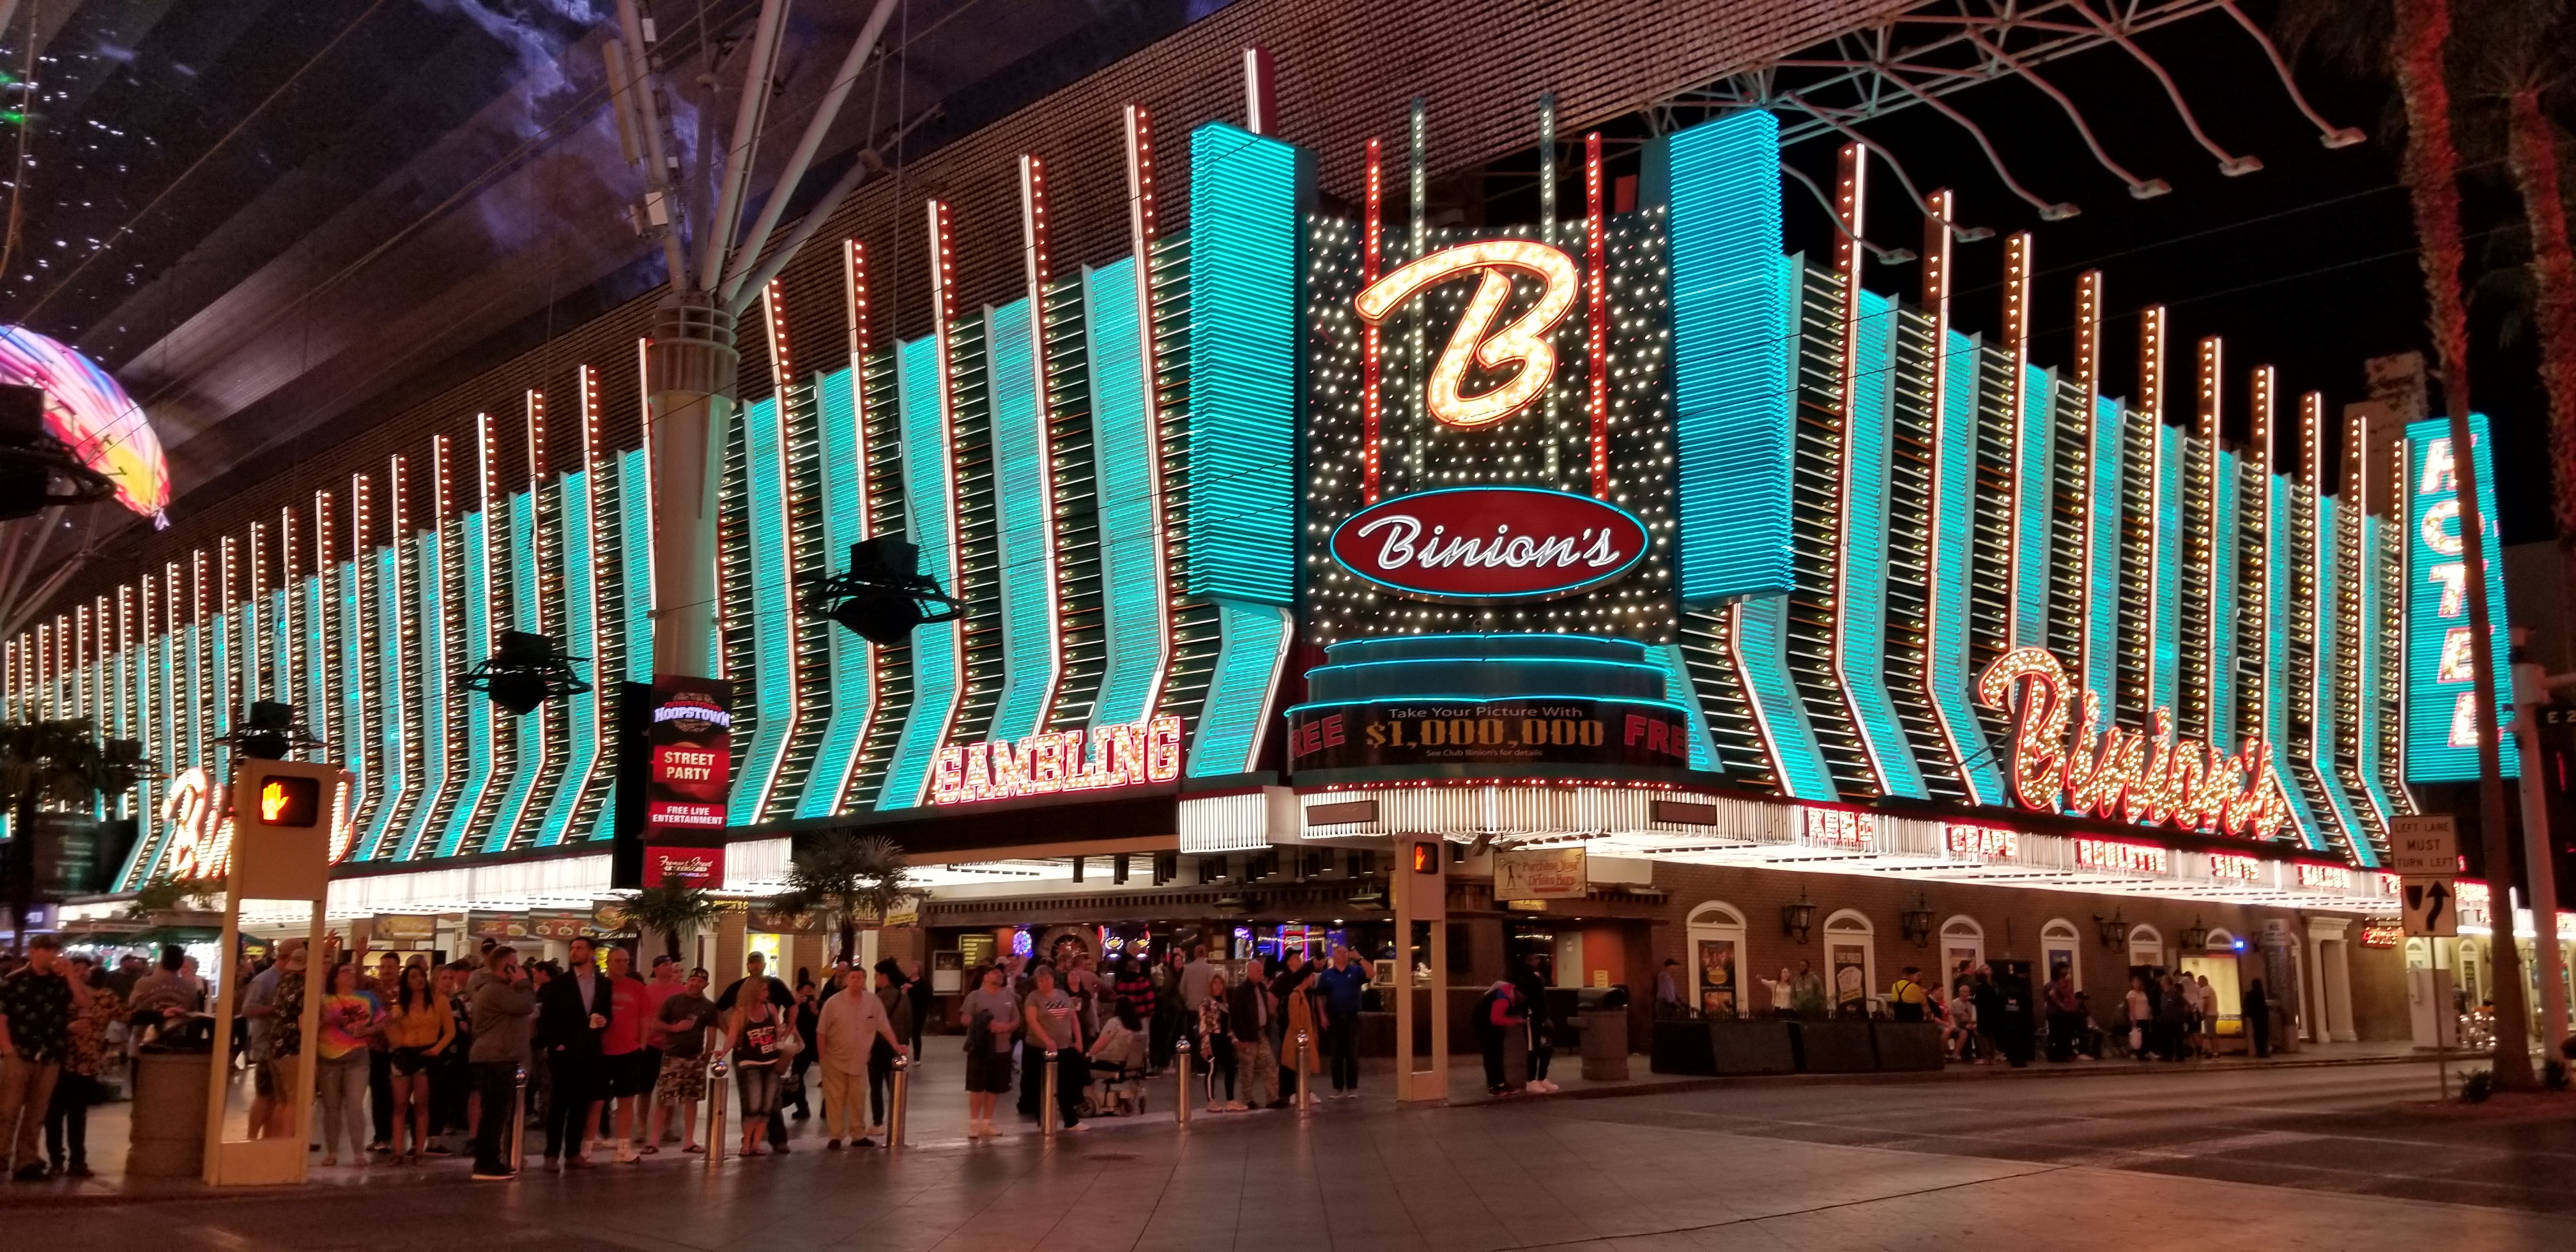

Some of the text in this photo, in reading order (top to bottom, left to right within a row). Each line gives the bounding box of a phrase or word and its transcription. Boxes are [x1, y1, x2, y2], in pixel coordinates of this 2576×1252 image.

[1354, 240, 1579, 427] B
[1358, 514, 1621, 570] Binion's
[654, 706, 730, 728] HOOPSTOWN
[1388, 706, 1583, 719] Take Your Picture With
[1291, 714, 1346, 761] REE
[1365, 718, 1604, 750] $1,000,000
[1624, 714, 1685, 759] FRE
[1978, 646, 2286, 841] Binion's
[664, 751, 716, 766] STREET
[935, 715, 1181, 806] GAMBLING
[666, 767, 711, 781] PARTY
[652, 814, 724, 825] ENTERTAINMENT
[666, 806, 710, 816] FREE LIVE
[2396, 822, 2450, 832] LEFT LANE
[1951, 824, 2017, 858] CRAPS
[2407, 839, 2441, 851] MUST
[2080, 839, 2167, 874] ROULETTE
[2398, 857, 2453, 867] TURN LEFT
